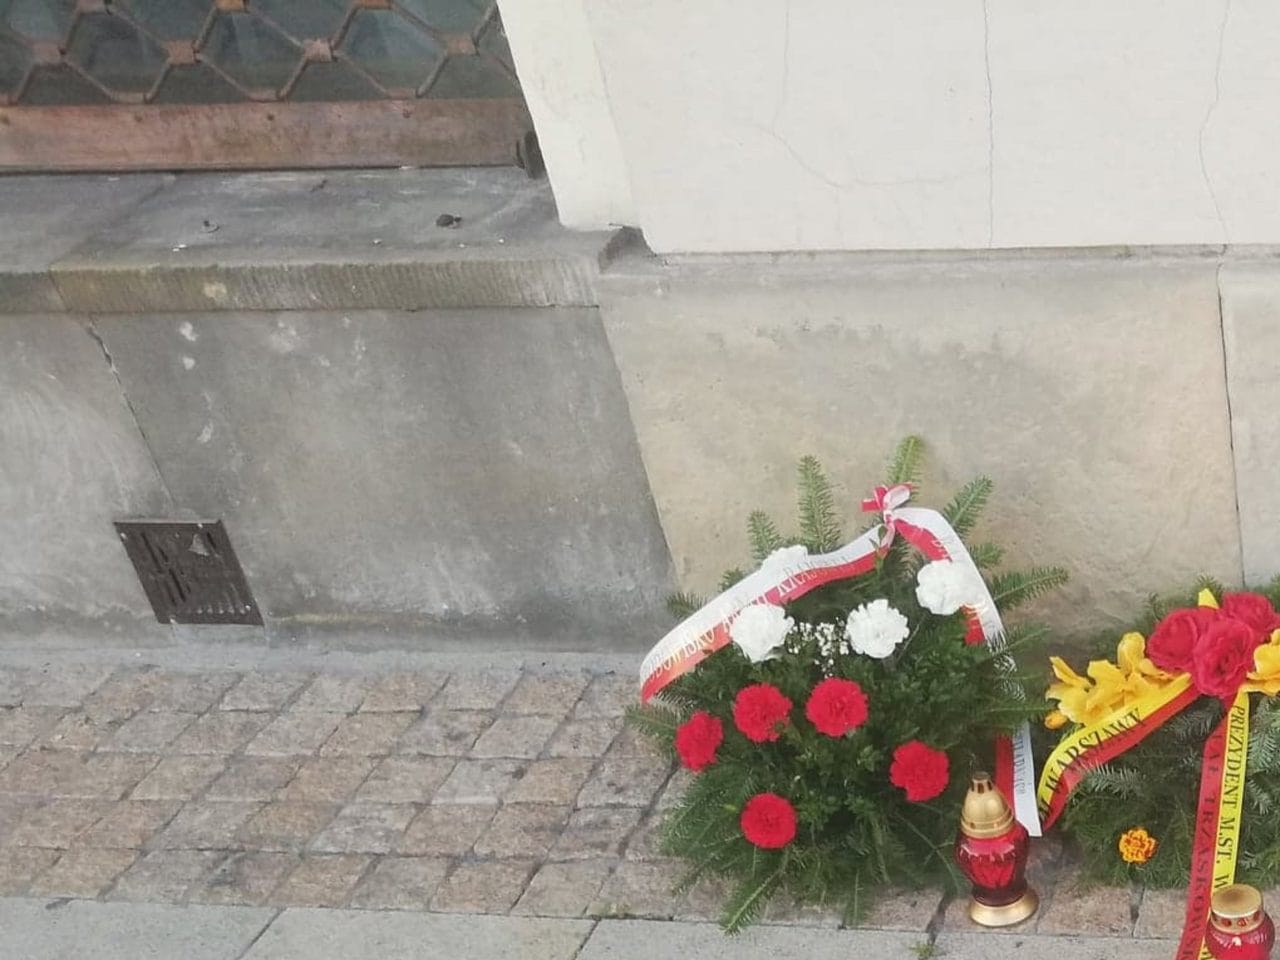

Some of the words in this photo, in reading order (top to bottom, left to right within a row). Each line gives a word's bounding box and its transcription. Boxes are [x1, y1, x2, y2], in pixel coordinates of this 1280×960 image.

[1044, 706, 1147, 794] WARSZAWY
[1222, 704, 1247, 810] PREZYDENT
[1215, 816, 1236, 865] M.ST.
